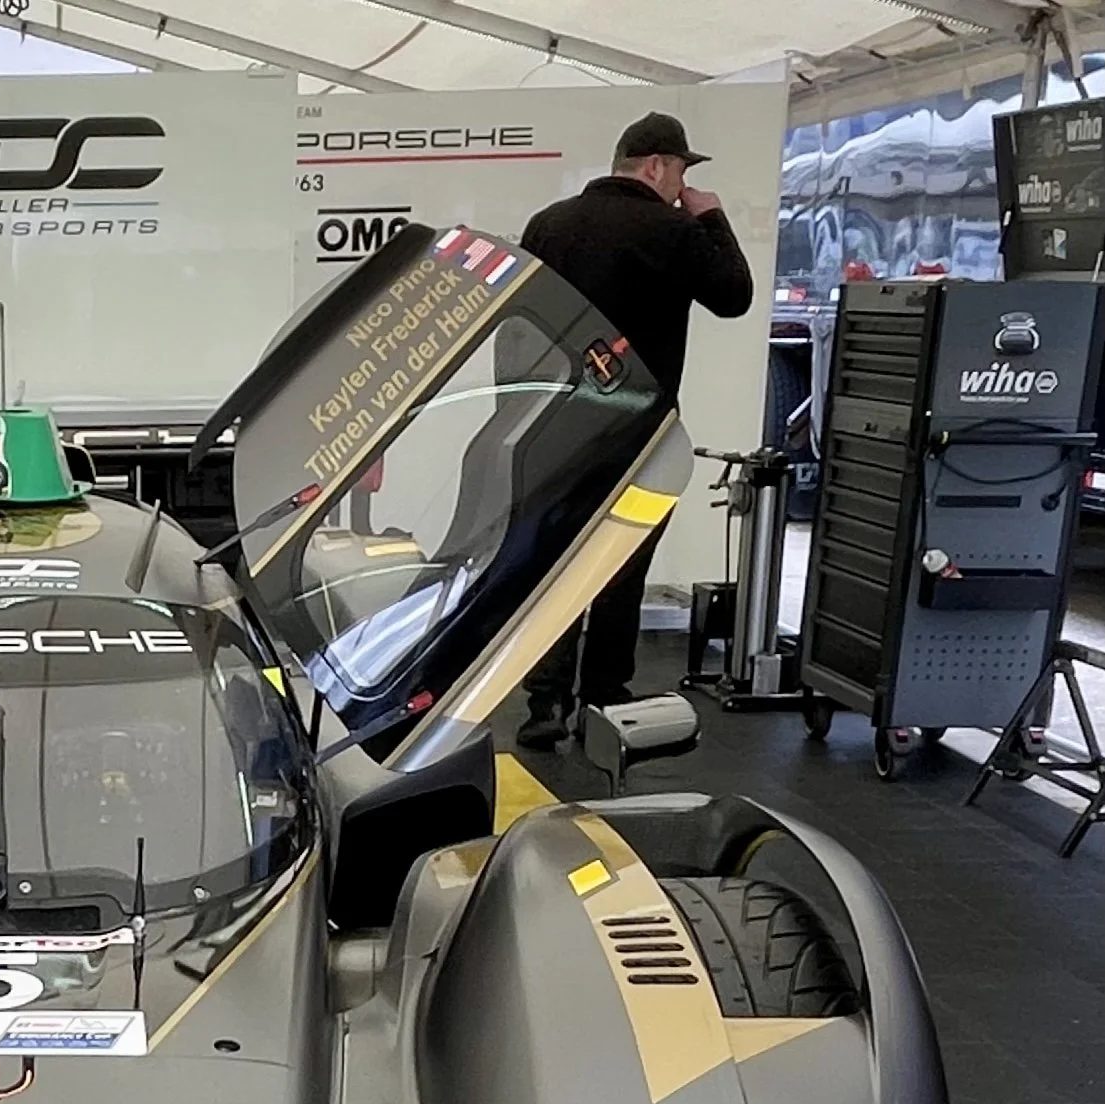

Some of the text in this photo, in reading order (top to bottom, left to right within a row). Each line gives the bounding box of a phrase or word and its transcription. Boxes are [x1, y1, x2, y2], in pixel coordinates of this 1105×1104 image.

[295, 174, 324, 192] 63
[1018, 174, 1051, 205] wiha
[346, 259, 435, 348] Nico Pino
[308, 269, 463, 433] Kaylen Frederick
[960, 362, 1036, 394] wiha
[304, 283, 491, 480] Tijmen van der Helm
